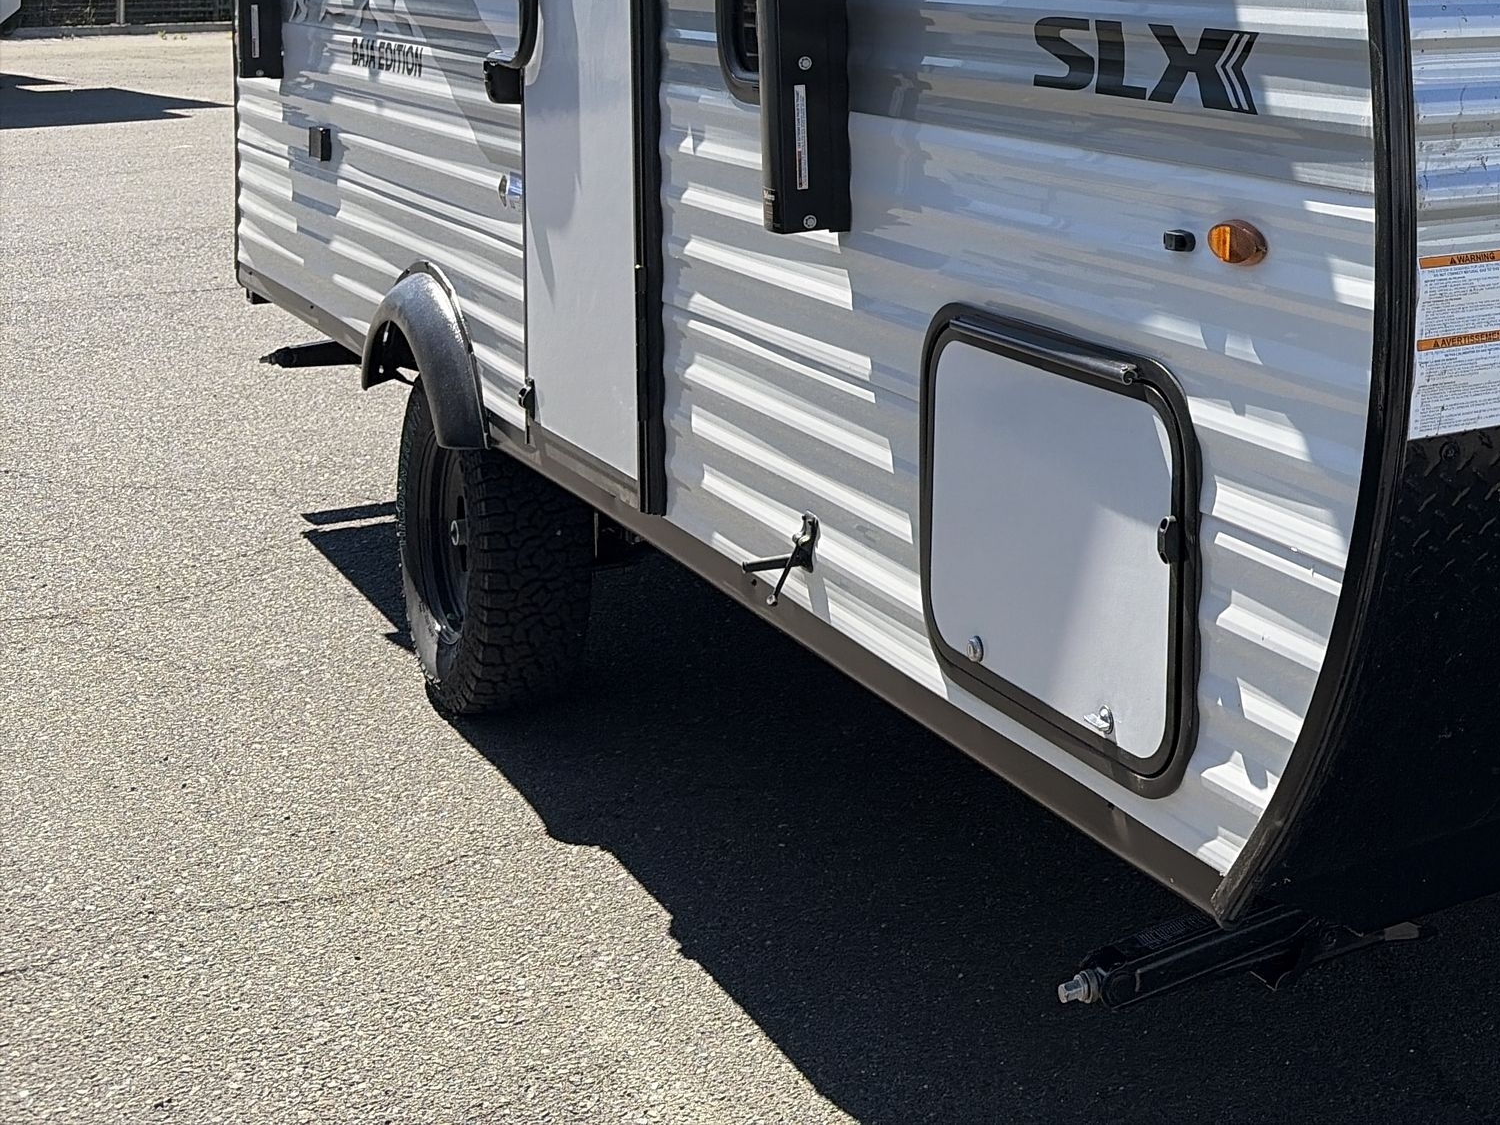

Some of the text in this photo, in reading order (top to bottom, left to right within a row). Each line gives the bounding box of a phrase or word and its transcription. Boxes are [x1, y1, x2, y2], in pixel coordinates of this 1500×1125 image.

[352, 38, 423, 78] BAJA EDITION
[1033, 16, 1259, 115] SLX
[1456, 252, 1496, 264] WARNING
